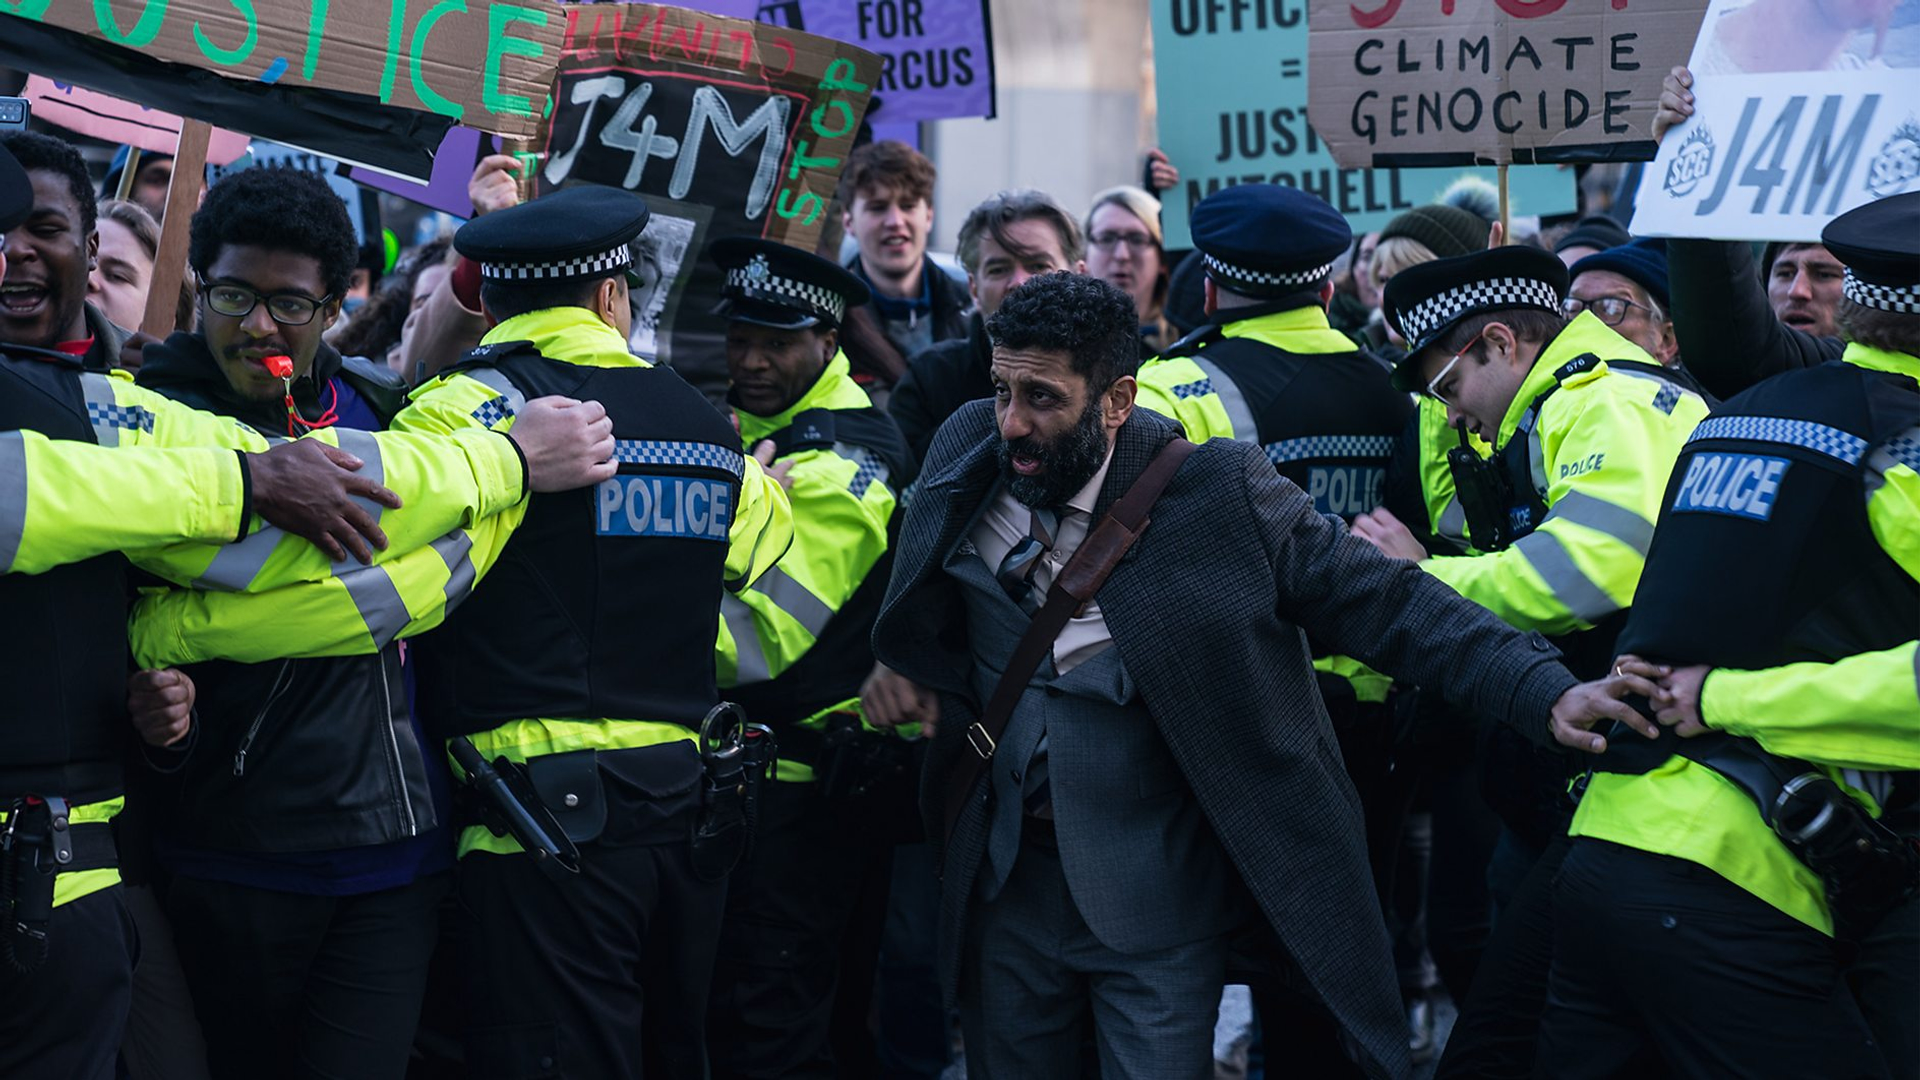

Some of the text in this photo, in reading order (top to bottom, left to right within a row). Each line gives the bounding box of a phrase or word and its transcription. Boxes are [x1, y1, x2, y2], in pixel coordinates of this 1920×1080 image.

[858, 0, 925, 40] FOR
[1171, 0, 1309, 36] OFFIC
[876, 46, 974, 92] RCUS
[1354, 33, 1641, 76] CLIMATE
[776, 57, 869, 226] STOP
[1216, 107, 1319, 163] JUST
[1351, 87, 1631, 145] GENOCIDE
[544, 75, 791, 220] J4M
[1668, 147, 1711, 187] SCG
[1694, 93, 1882, 216] J4M
[1311, 468, 1387, 514] POLIC
[1560, 454, 1605, 480] POLICE
[1674, 455, 1786, 517] POLICE
[600, 478, 728, 538] POLICE
